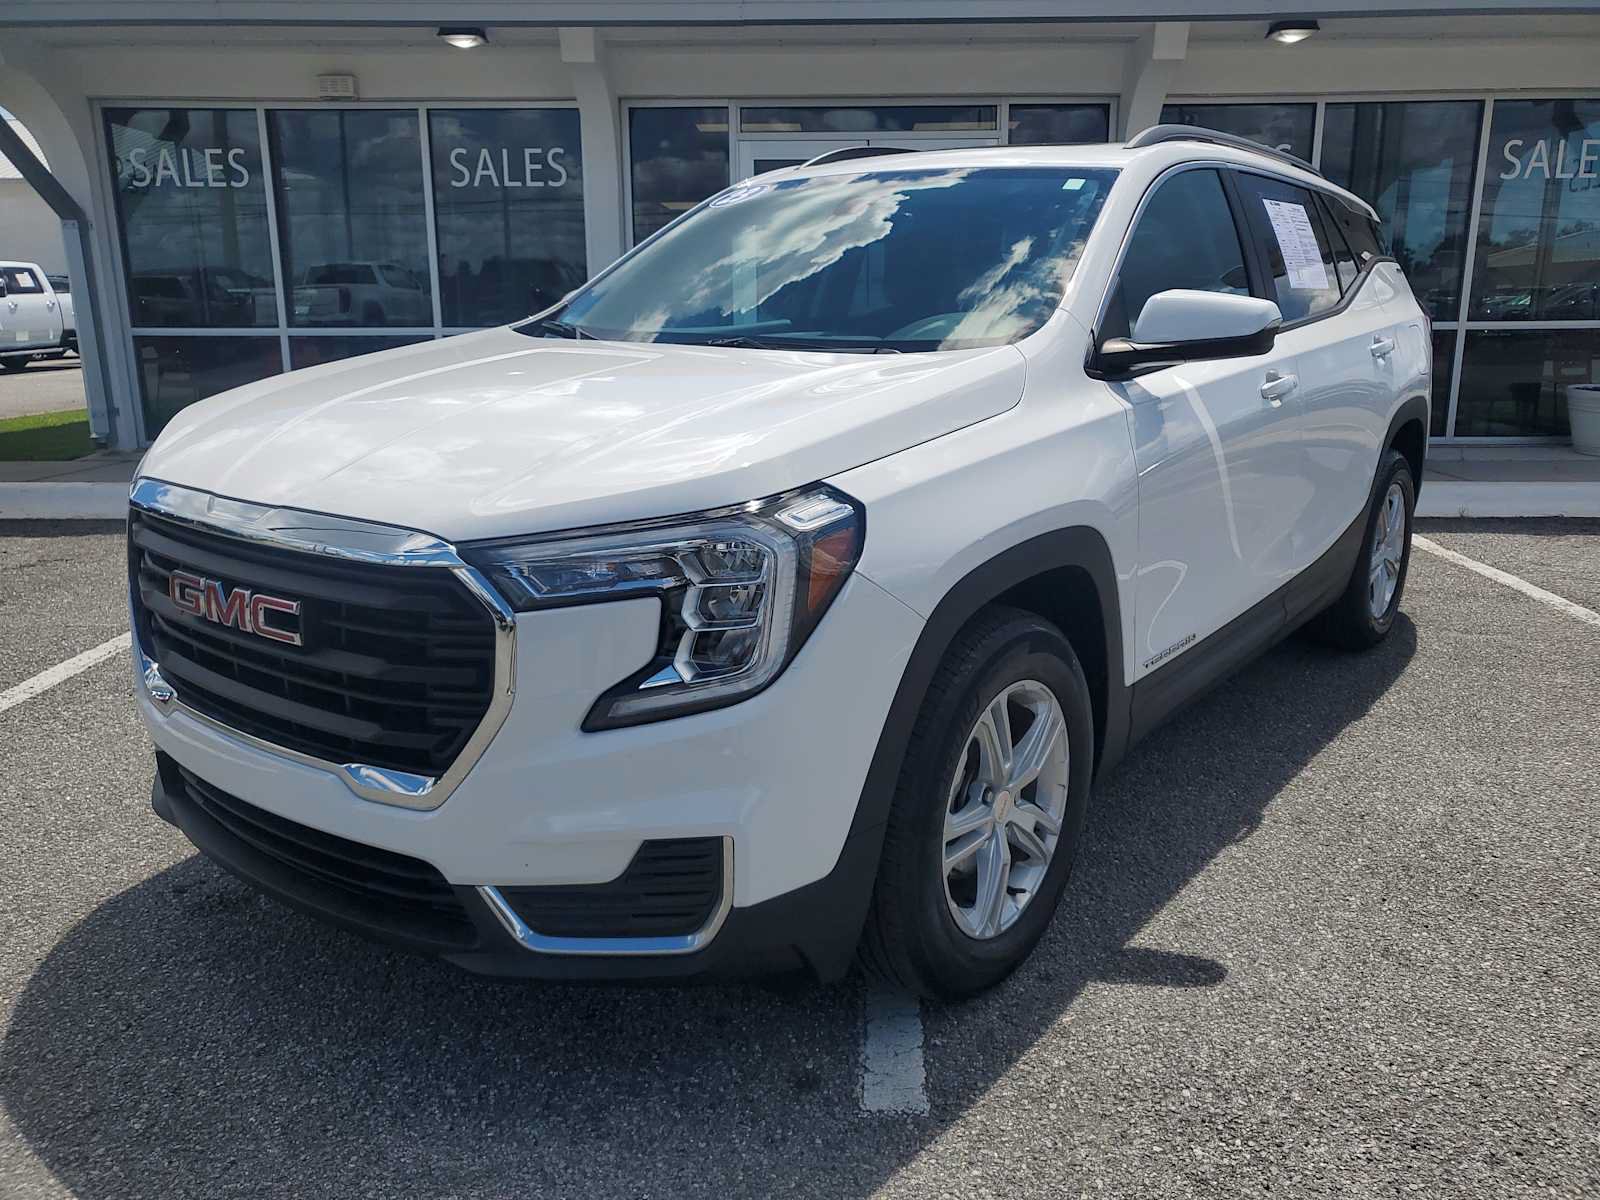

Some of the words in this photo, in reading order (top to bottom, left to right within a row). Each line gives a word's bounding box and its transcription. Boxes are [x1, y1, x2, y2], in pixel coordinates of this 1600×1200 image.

[129, 147, 250, 188] SALES
[450, 147, 568, 188] SALES
[1500, 139, 1600, 180] SALE
[169, 569, 304, 647] GMC
